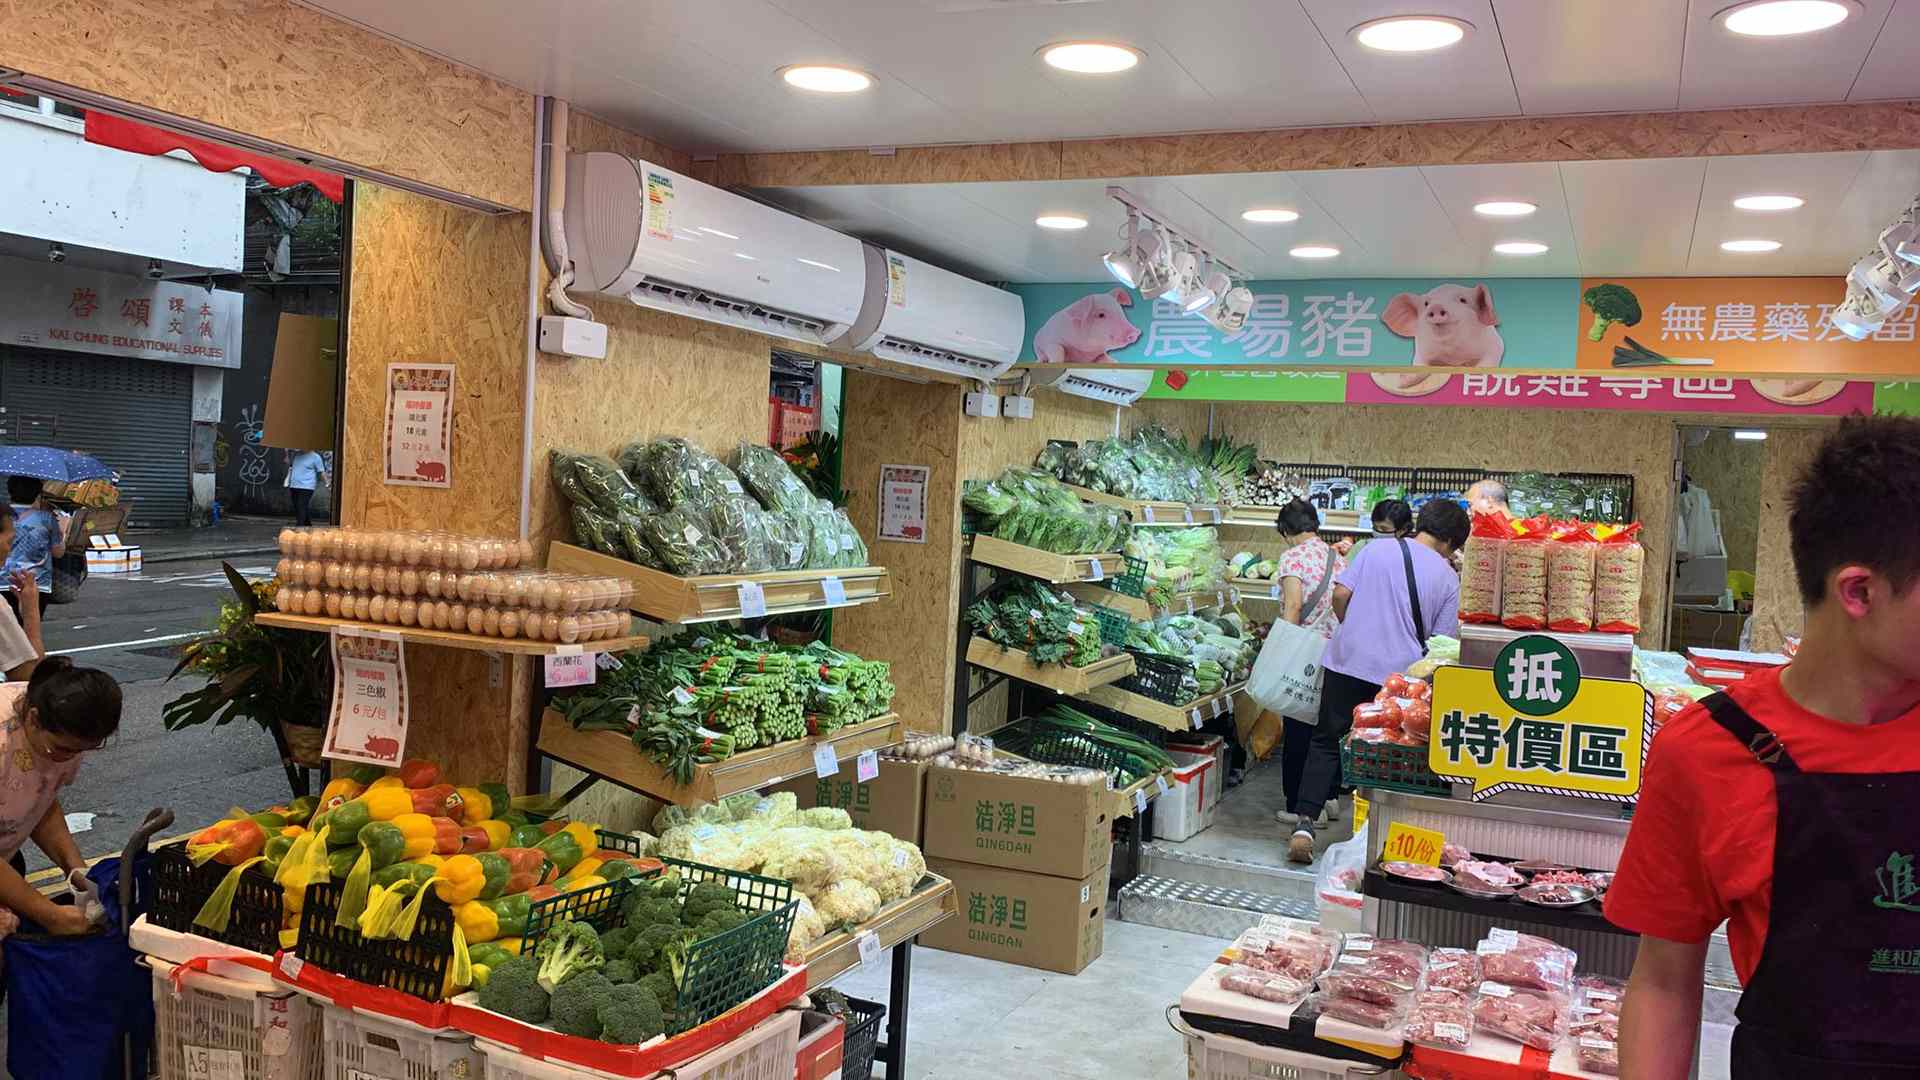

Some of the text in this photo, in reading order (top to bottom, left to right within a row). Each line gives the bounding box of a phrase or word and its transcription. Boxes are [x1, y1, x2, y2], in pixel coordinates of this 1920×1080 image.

[48, 328, 225, 358] KAI CHUNG EDUCATIONAL SUPPLIES
[1508, 648, 1563, 704] 抵
[355, 683, 387, 700] 三色椒
[1440, 710, 1627, 780] 特價區
[976, 837, 1032, 855] QINGDAN
[968, 928, 1023, 949] QINGDAN
